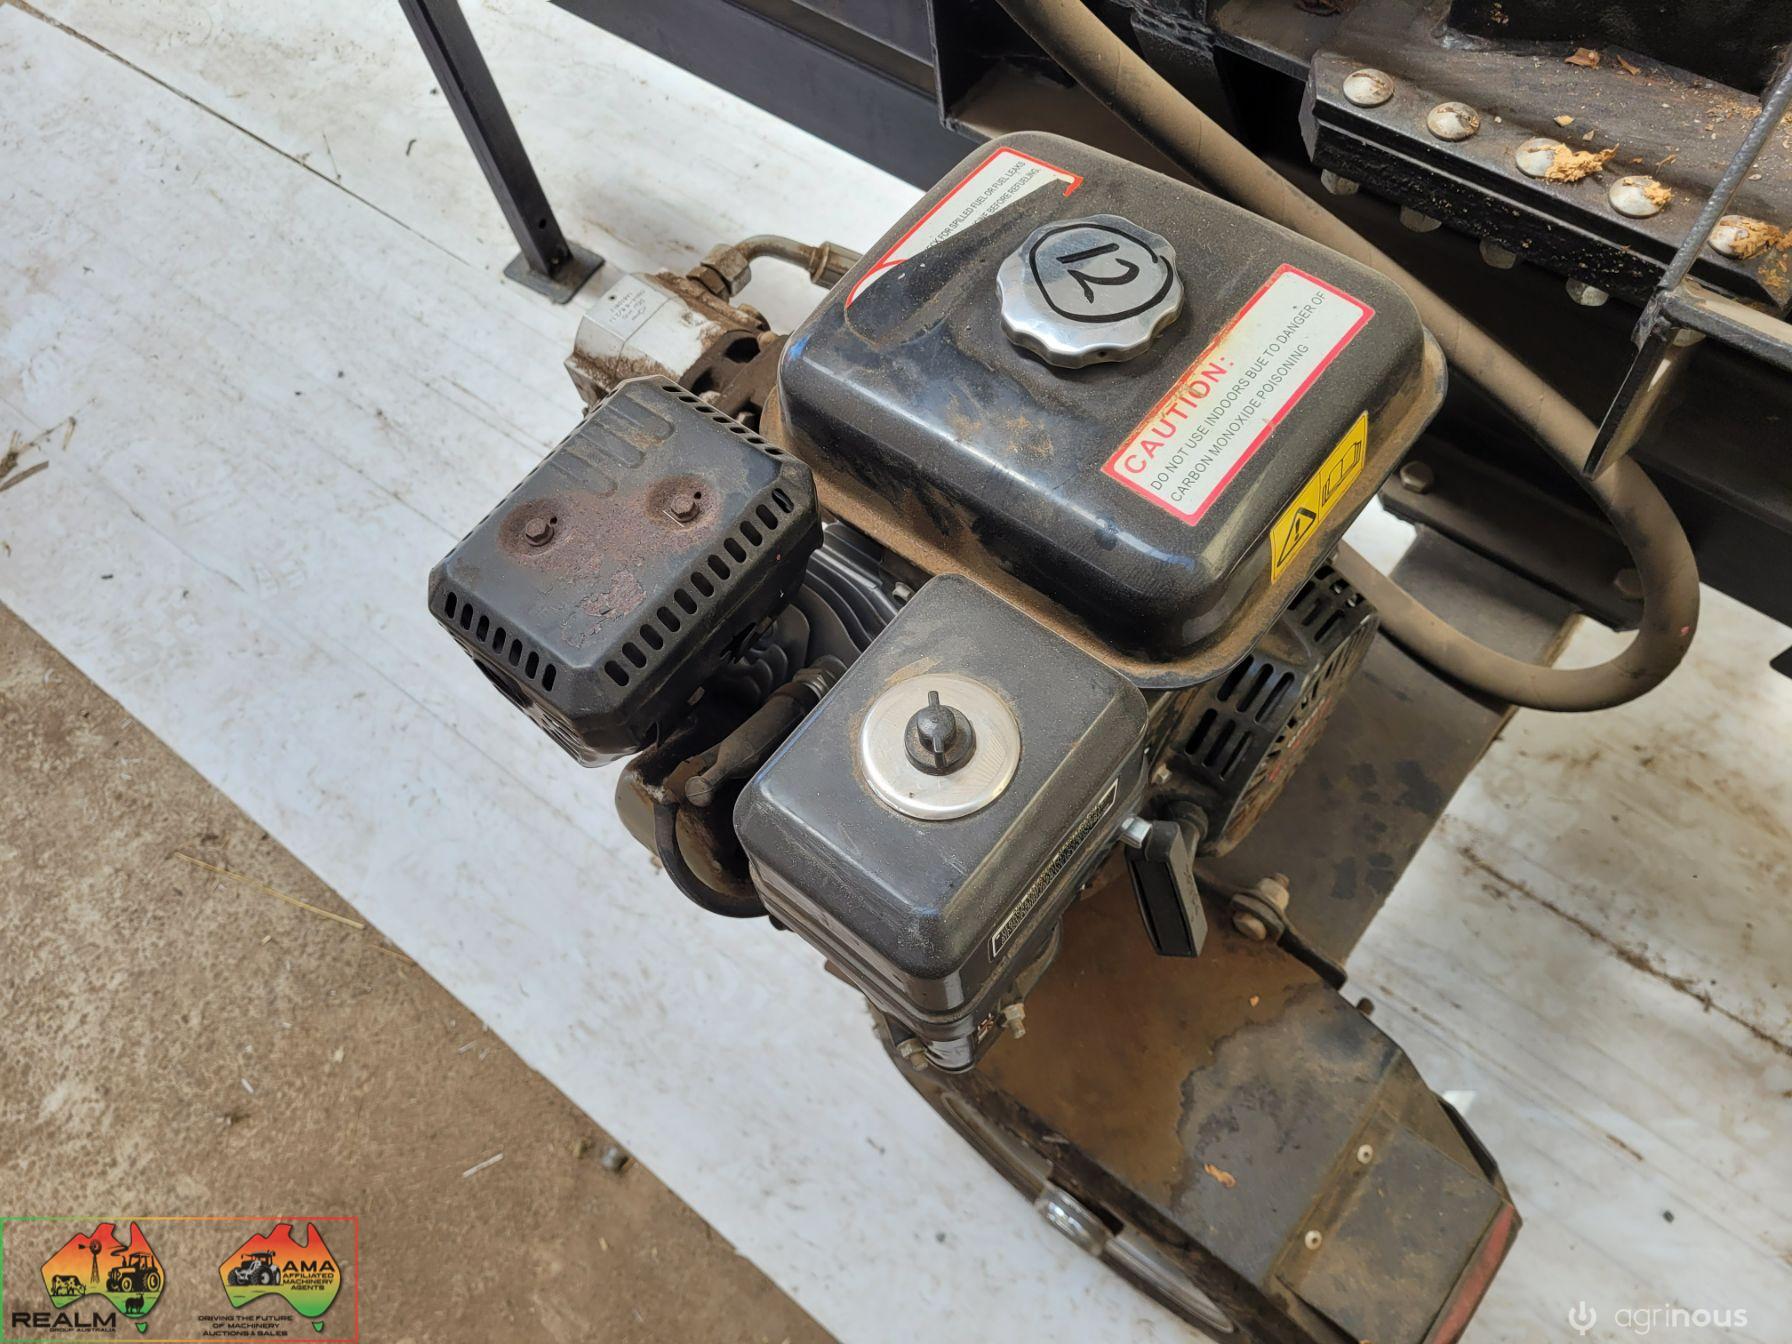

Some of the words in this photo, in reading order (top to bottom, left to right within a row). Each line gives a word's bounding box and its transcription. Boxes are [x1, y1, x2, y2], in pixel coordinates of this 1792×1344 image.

[938, 227, 951, 240] FOR
[949, 206, 974, 230] SPILLED
[970, 196, 986, 209] FUEL
[984, 186, 996, 198] OR
[993, 176, 1007, 189] FUEL
[987, 192, 1010, 213] BEFORE
[1124, 356, 1234, 474] CAUTION:
[1150, 472, 1170, 492] DO
[1168, 447, 1188, 474] NOT
[1188, 424, 1210, 450] USE
[1206, 378, 1250, 427] INDOORS
[1246, 353, 1270, 379] BUE
[1262, 343, 1281, 361] TO
[1276, 304, 1316, 344] DANGER
[1311, 290, 1326, 308] OF
[1170, 454, 1214, 502] CARBON
[1211, 399, 1263, 456] MONOXIDE
[1258, 343, 1309, 401] POISONING
